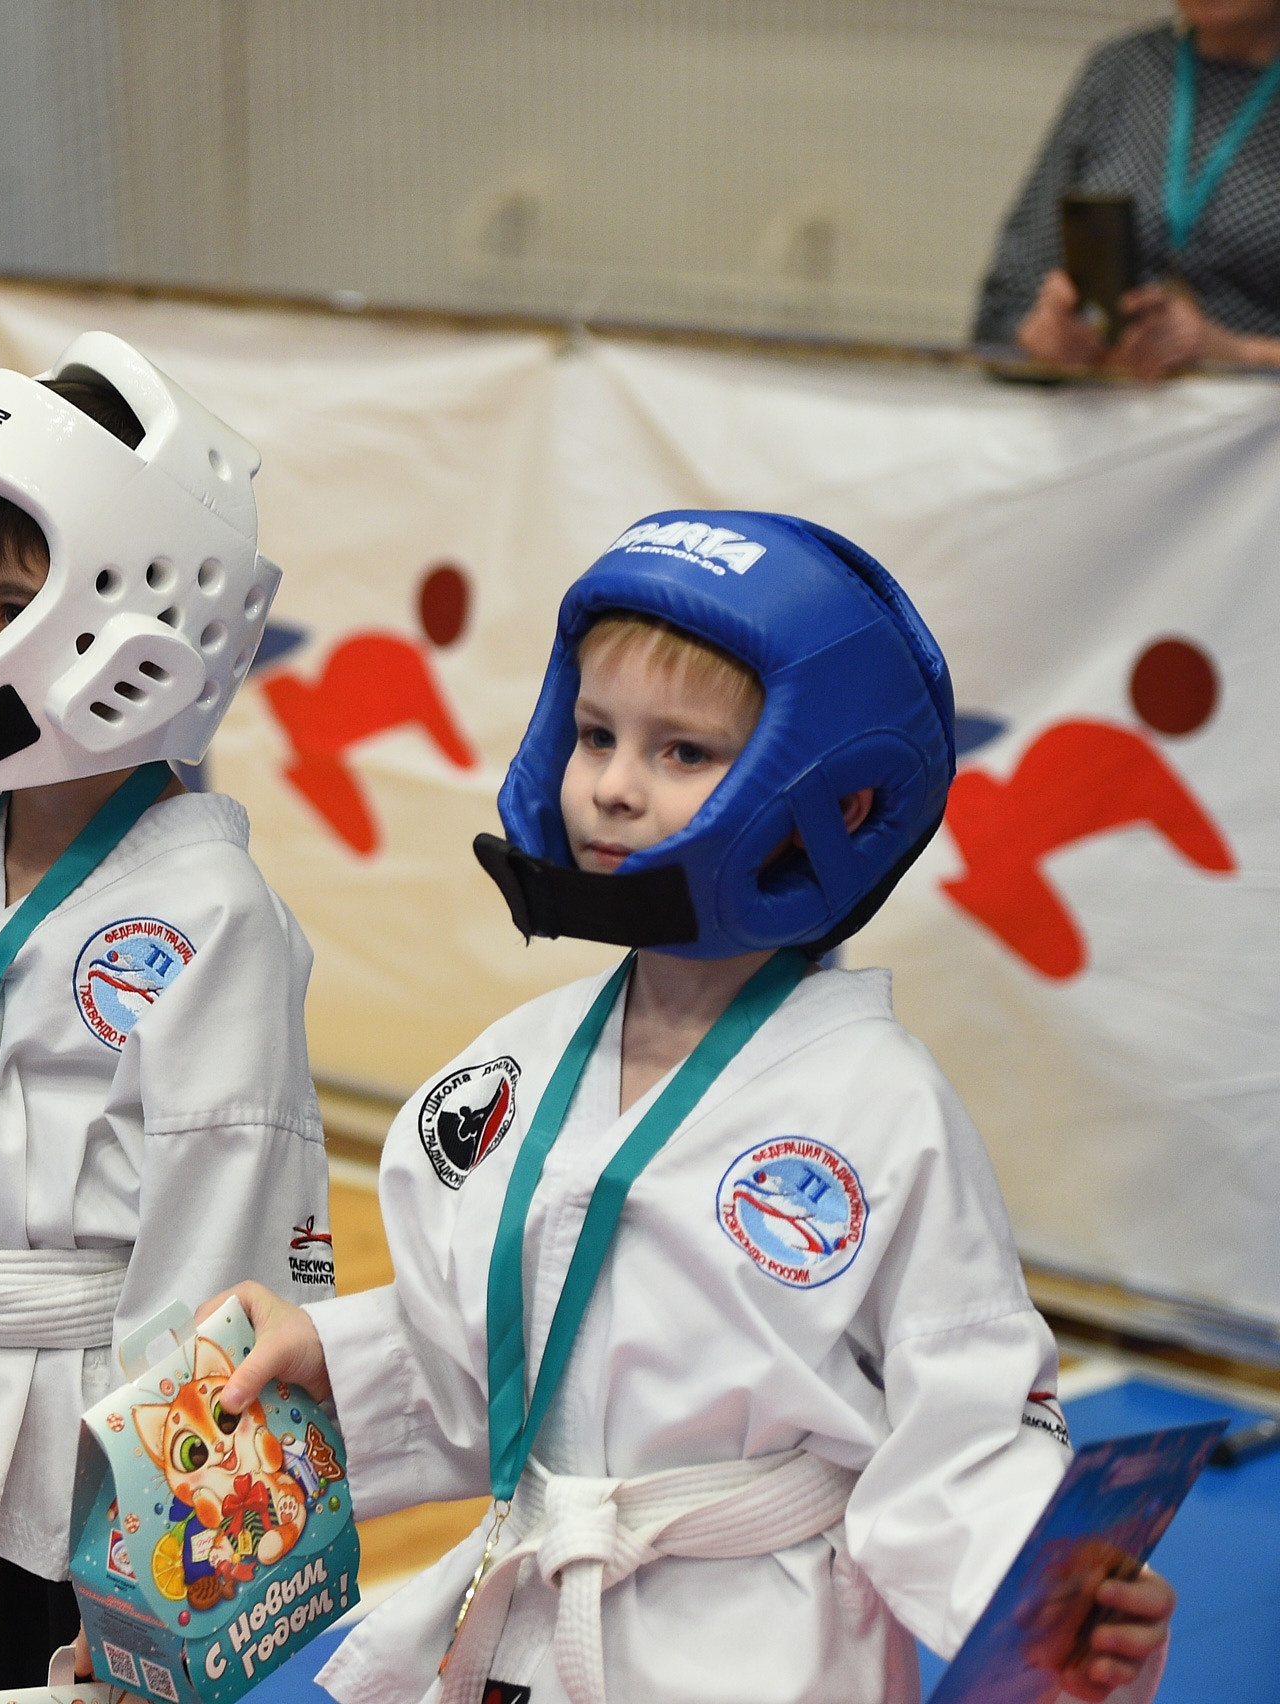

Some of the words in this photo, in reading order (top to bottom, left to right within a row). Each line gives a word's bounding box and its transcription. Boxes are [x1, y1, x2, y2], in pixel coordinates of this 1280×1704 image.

[625, 546, 726, 576] TAEKWON-DO
[104, 922, 163, 944] ФЕДЕРАЦИЯ
[752, 1141, 823, 1163] ФЕДЕРАЦИЯ
[768, 1260, 811, 1284] РОССИИ
[204, 1641, 227, 1680] С
